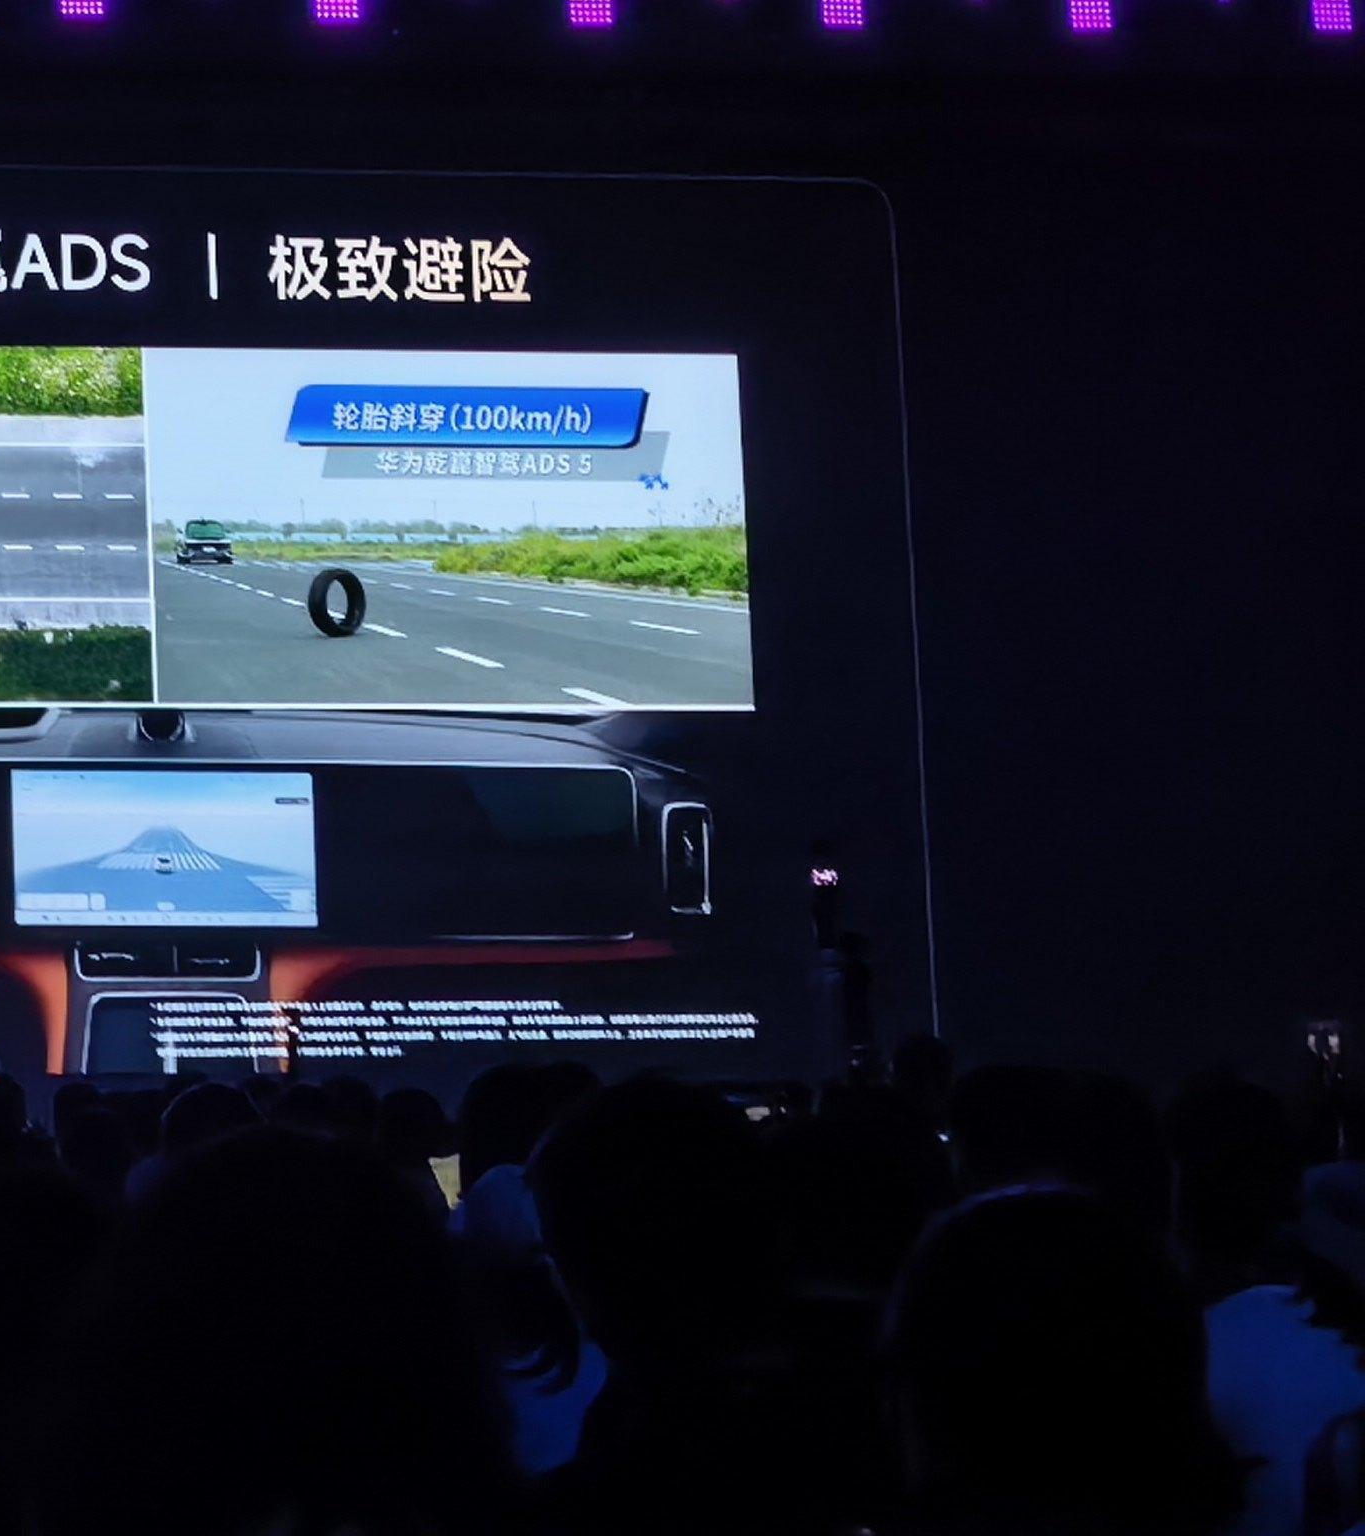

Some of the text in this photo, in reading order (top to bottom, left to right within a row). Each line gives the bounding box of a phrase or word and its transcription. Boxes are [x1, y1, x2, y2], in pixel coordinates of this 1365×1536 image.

[267, 233, 533, 303] 极致避险
[578, 453, 592, 475] 5
